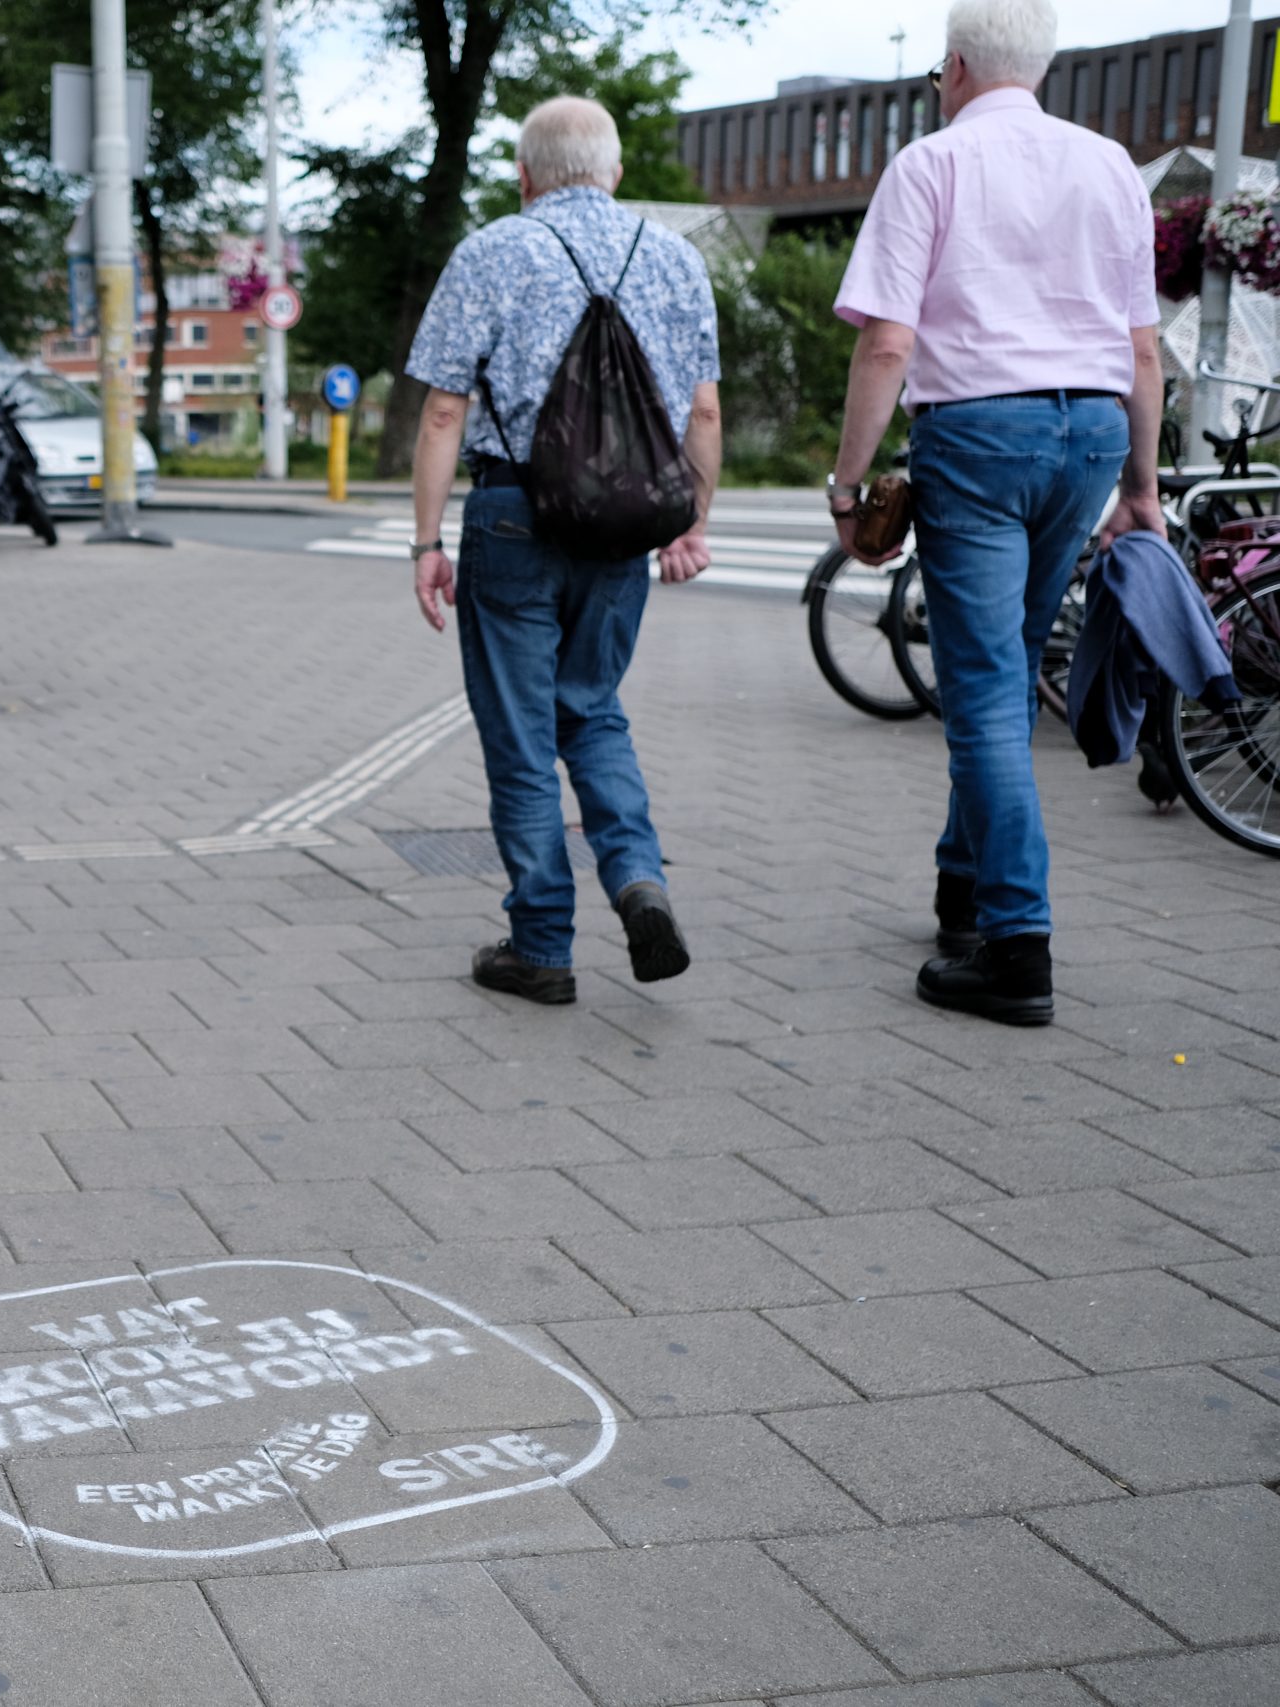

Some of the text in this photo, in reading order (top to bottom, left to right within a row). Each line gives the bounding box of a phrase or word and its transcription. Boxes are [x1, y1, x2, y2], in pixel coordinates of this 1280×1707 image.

[28, 1296, 221, 1347] WAT
[314, 1413, 370, 1457] DAG
[288, 1453, 341, 1482] JE
[378, 1434, 570, 1492] SIRE
[76, 1480, 177, 1503] EEN
